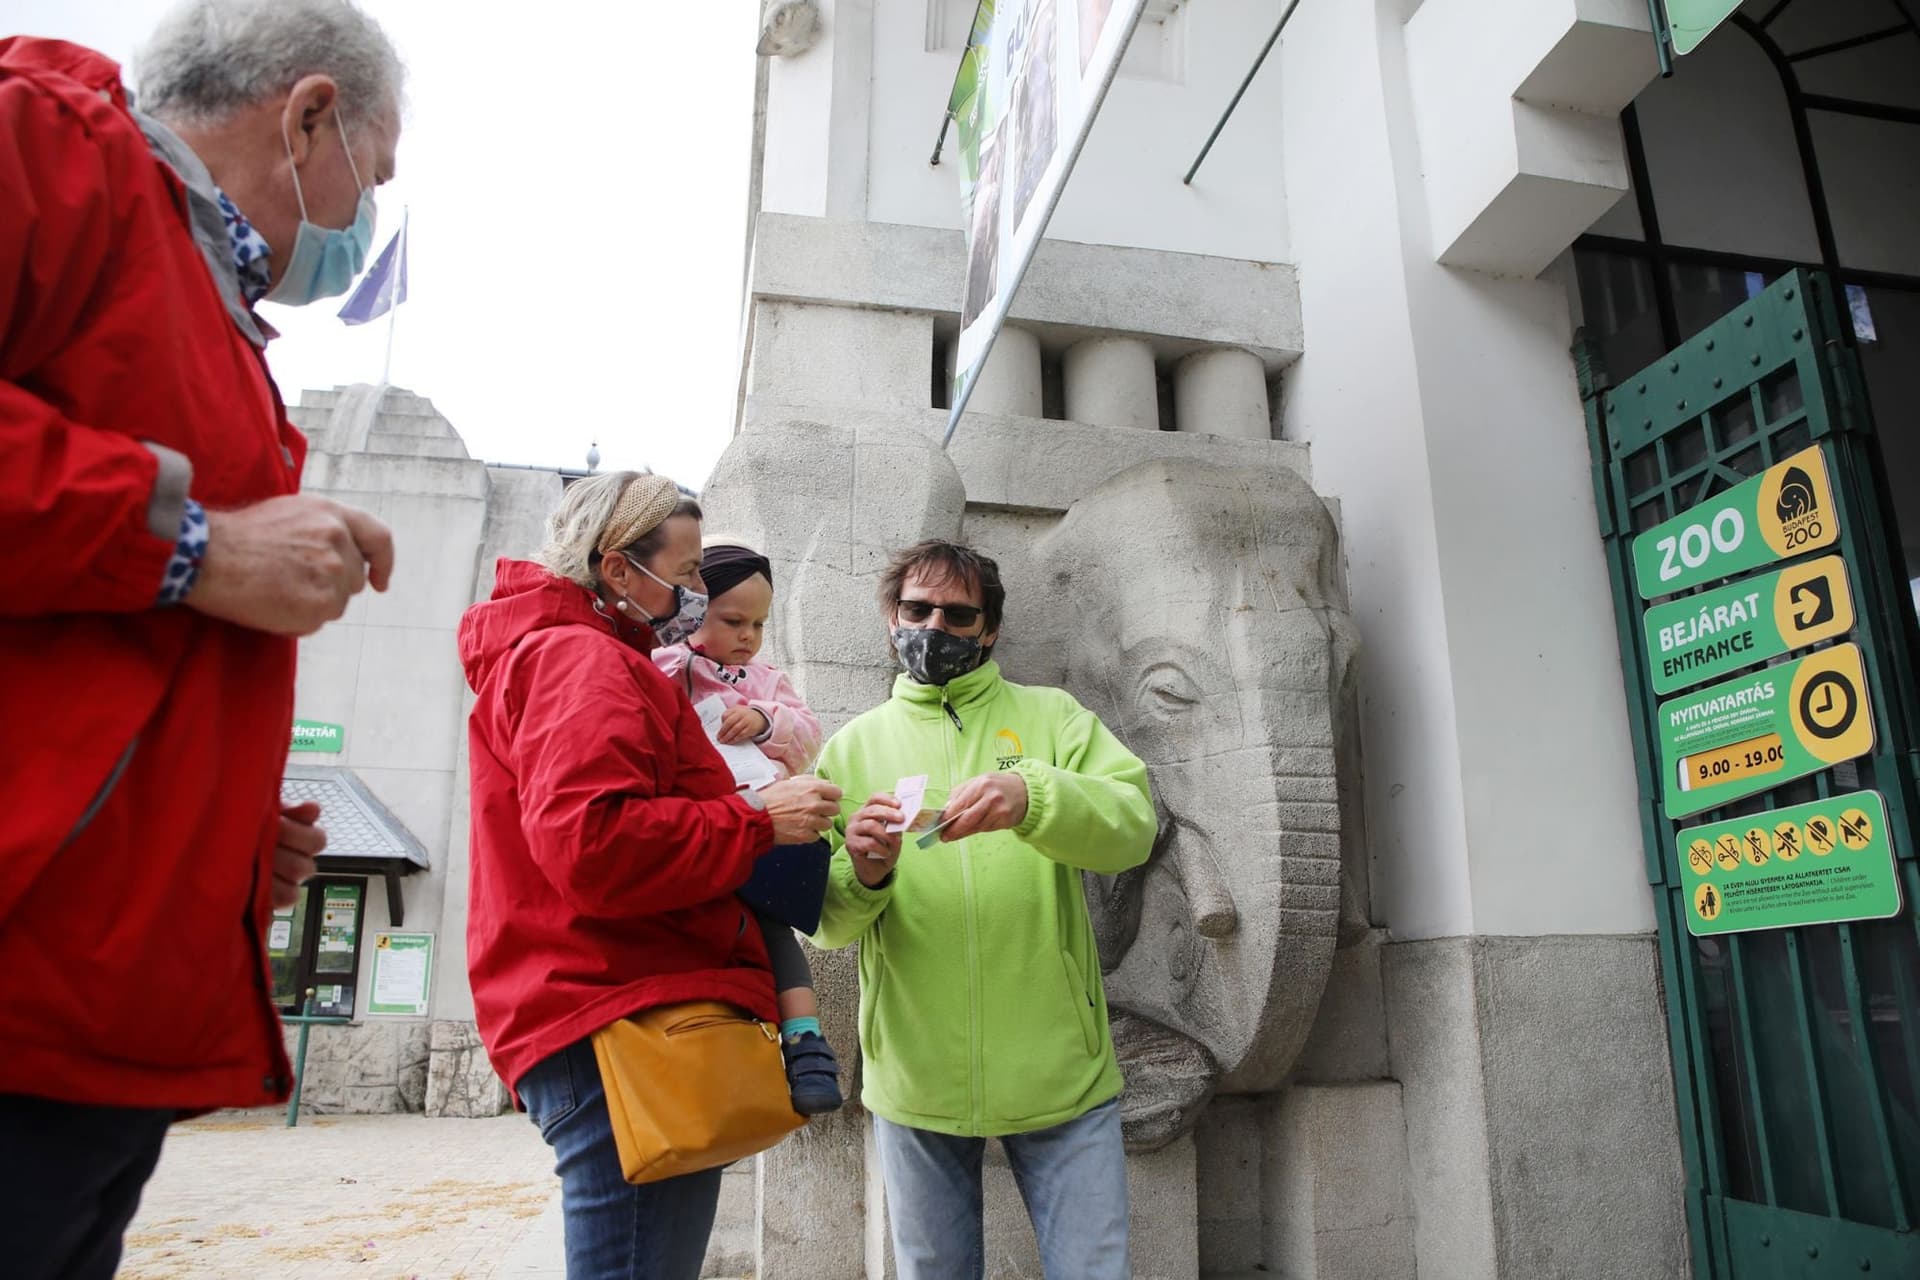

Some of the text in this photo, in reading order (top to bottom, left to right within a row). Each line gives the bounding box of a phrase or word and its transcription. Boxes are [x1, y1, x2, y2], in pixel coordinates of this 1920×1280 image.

[1782, 511, 1819, 534] BUDAPEST
[1785, 521, 1822, 550] ZOO
[1656, 507, 1745, 581] ZOO
[1659, 592, 1760, 652] BEJÁRAT
[1663, 630, 1754, 678] ENTRANCE
[1670, 681, 1776, 727] NYITVATARTÁS
[292, 738, 315, 747] ASSA
[1699, 758, 1730, 780] 9.00
[1834, 866, 1852, 874] CSAK
